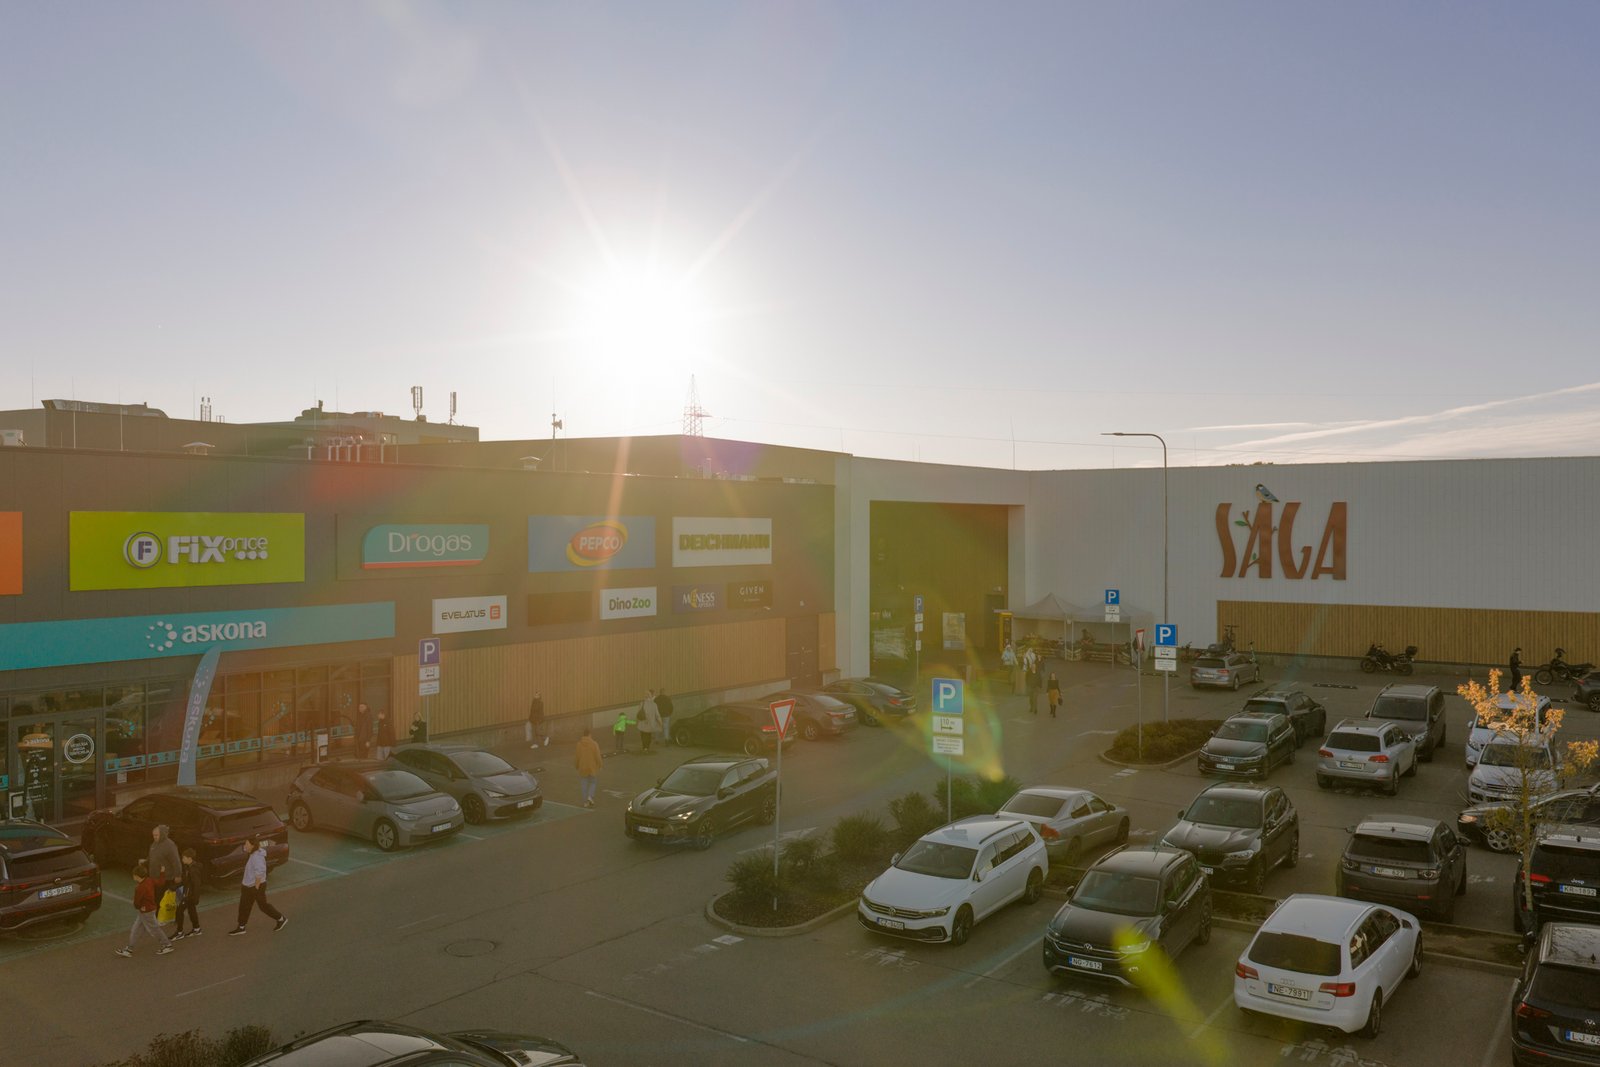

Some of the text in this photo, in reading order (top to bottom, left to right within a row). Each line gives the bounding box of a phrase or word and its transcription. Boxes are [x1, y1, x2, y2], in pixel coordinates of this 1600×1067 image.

[223, 537, 269, 555] price
[388, 532, 472, 556] Drogas
[579, 535, 620, 551] PEPCO
[1215, 502, 1347, 580] SAGA
[739, 585, 764, 596] GIVEN
[1108, 591, 1117, 603] P
[441, 609, 486, 621] EVELATUS
[181, 620, 267, 643] askona
[1159, 626, 1172, 643] P
[423, 642, 436, 663] P
[939, 682, 956, 708] P
